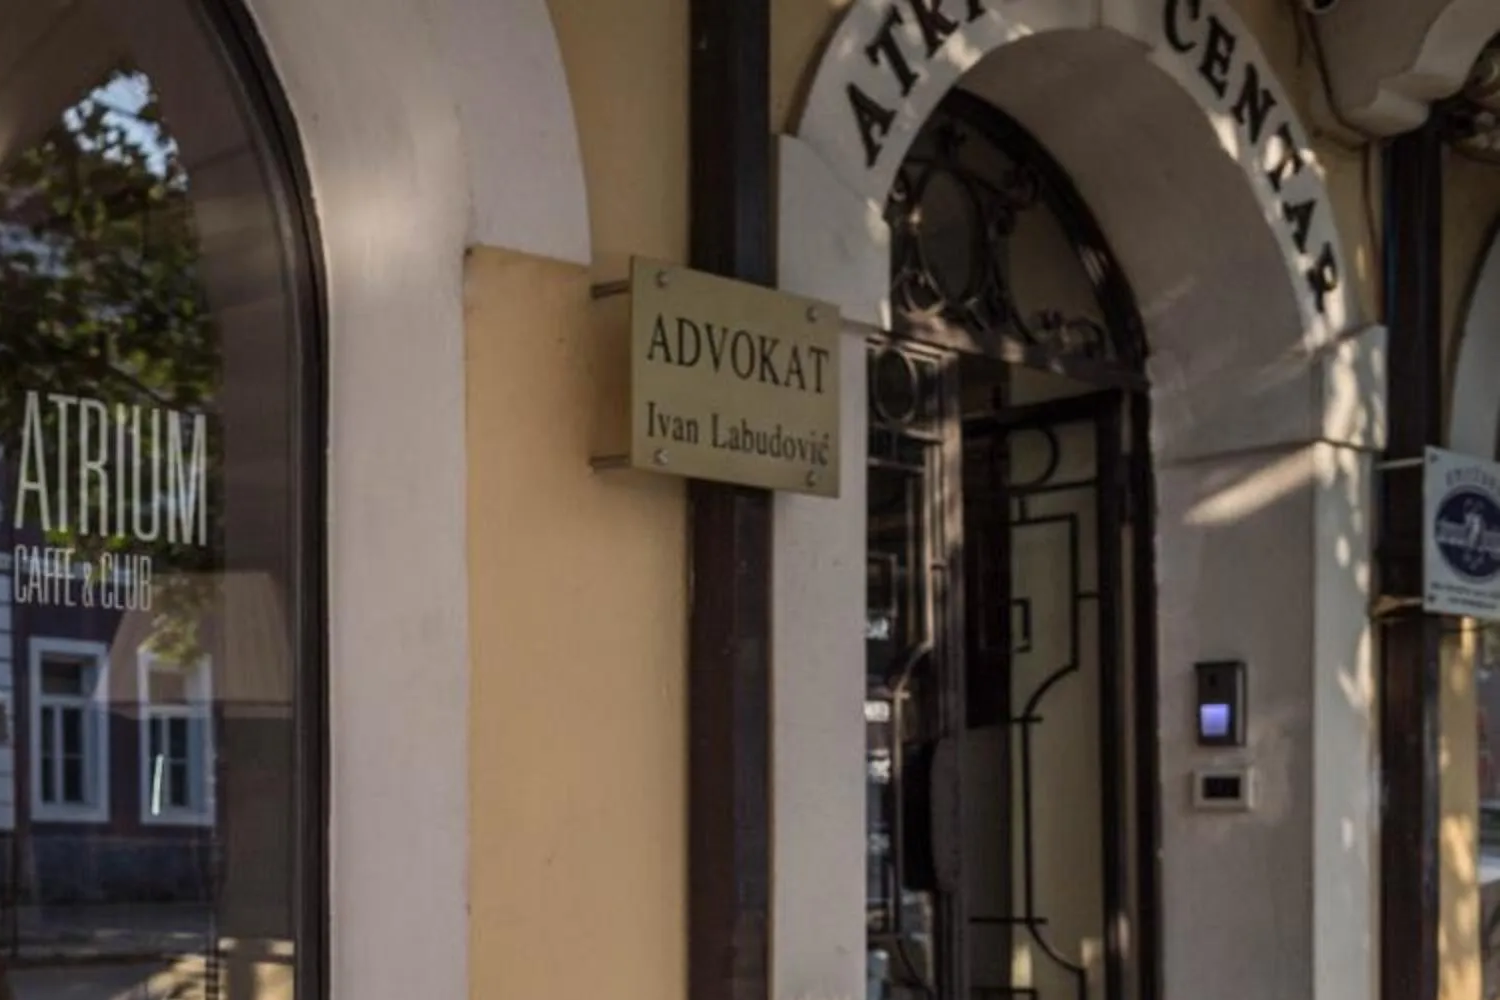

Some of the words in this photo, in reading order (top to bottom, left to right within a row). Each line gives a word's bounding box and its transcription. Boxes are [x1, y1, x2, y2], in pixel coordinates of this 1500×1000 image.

[1164, 0, 1337, 314] CENTAR
[647, 312, 830, 394] ADVOKAT
[647, 401, 700, 444] Ivan
[14, 390, 207, 546] ATRIUM
[14, 544, 77, 607] CAFFE
[82, 561, 95, 608] &
[101, 552, 153, 613] CLUB
